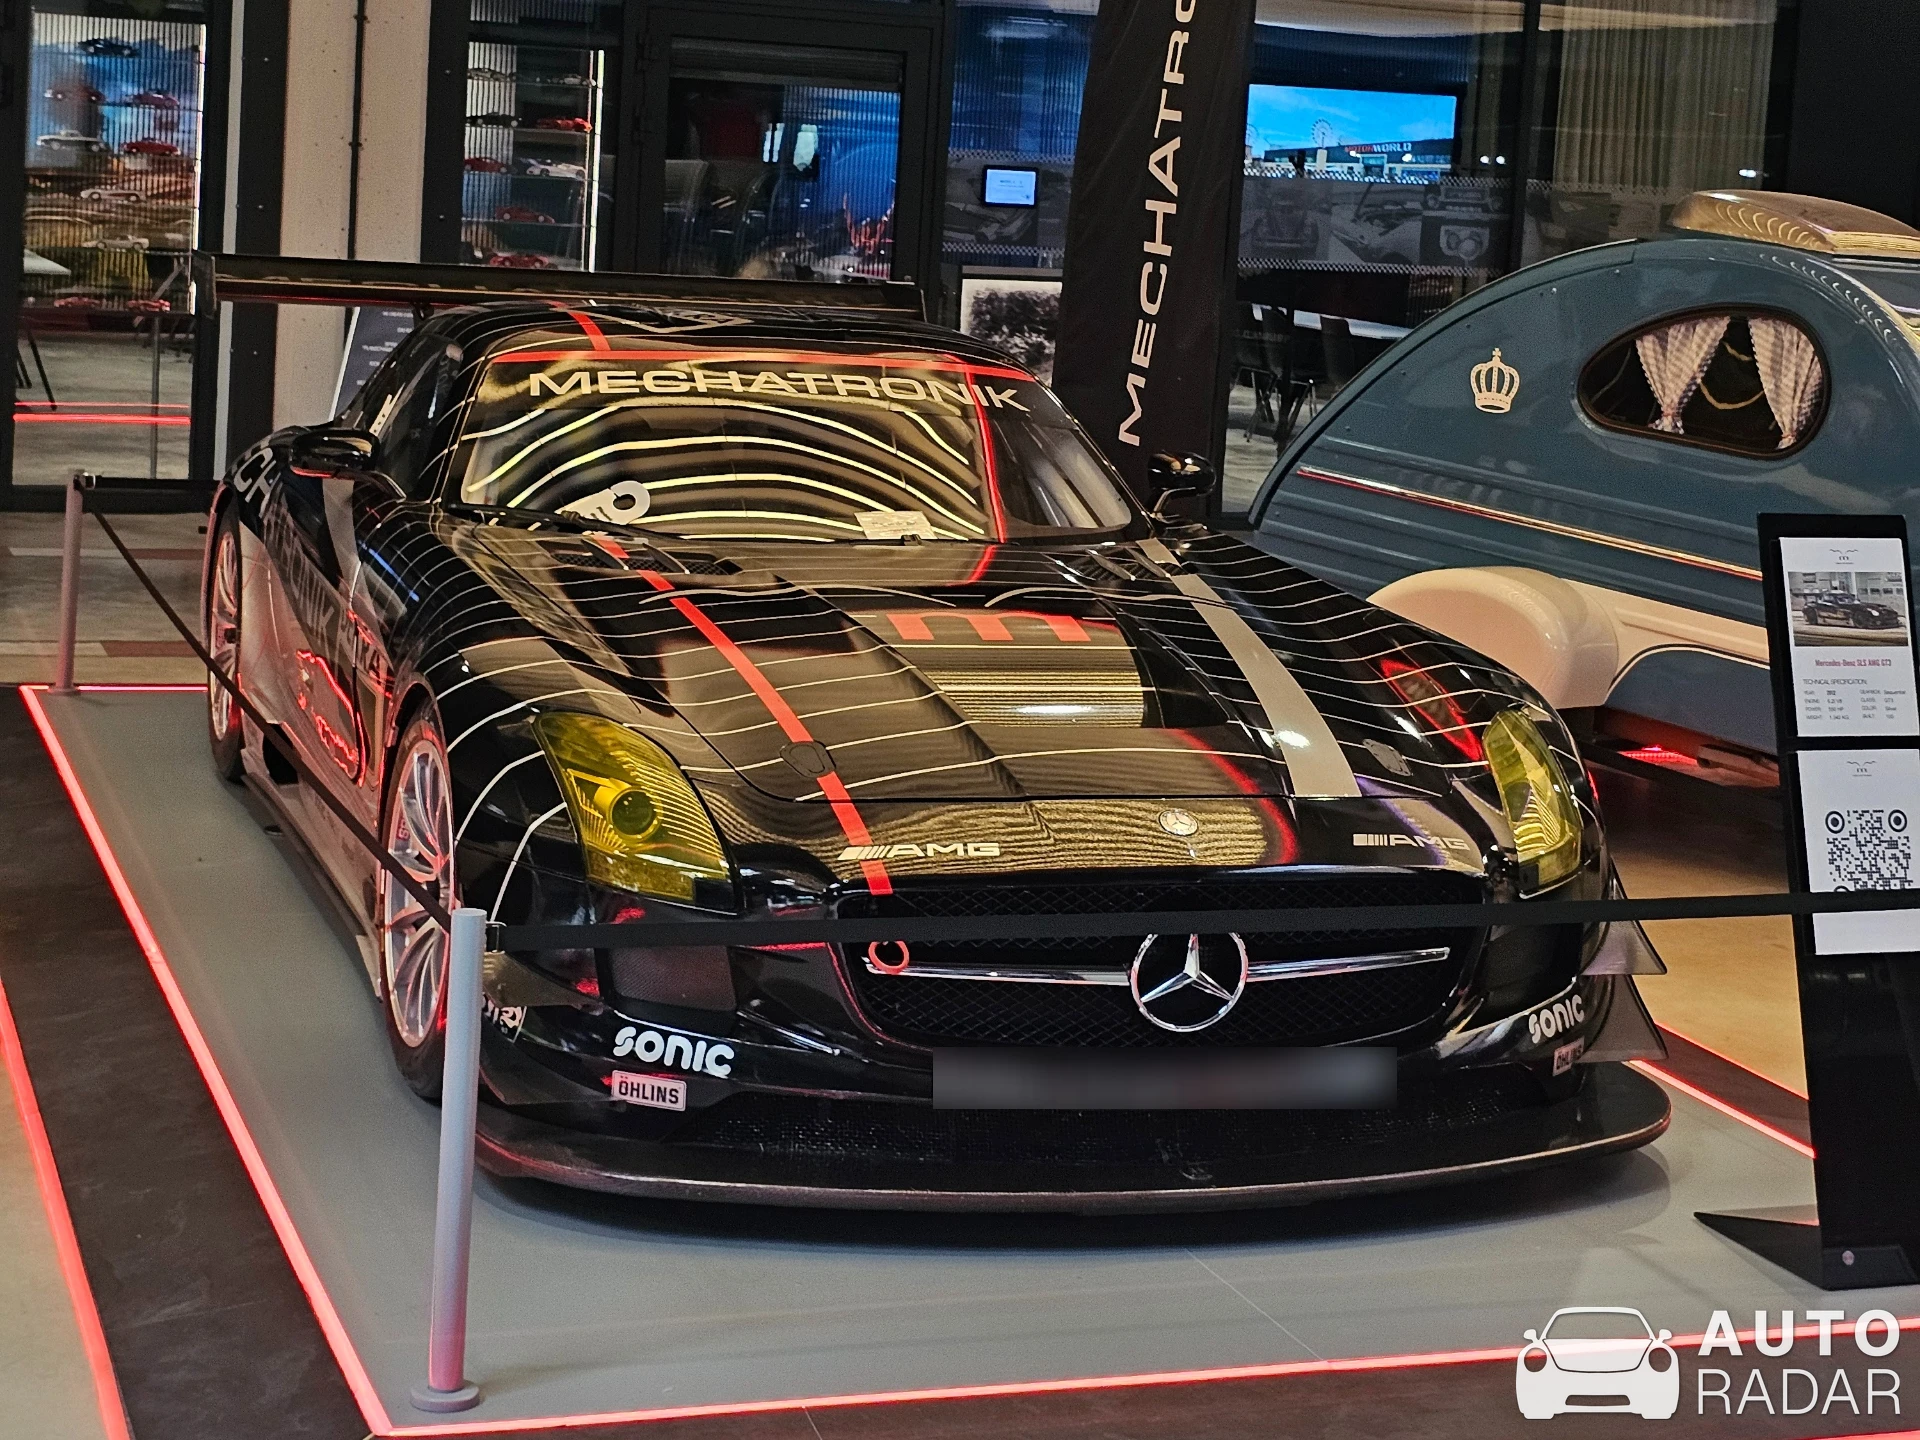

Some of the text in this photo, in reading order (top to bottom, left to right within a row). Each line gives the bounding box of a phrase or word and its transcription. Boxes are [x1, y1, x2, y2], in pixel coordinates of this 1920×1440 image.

[529, 370, 1031, 412] MECHATRONIK
[1815, 659, 1856, 667] Mercedes-Benz
[1857, 659, 1867, 667] SLS
[1868, 659, 1881, 667] AMG
[887, 842, 1001, 858] AMG
[1389, 833, 1471, 851] AMG
[618, 1076, 680, 1105] ÖHLINS
